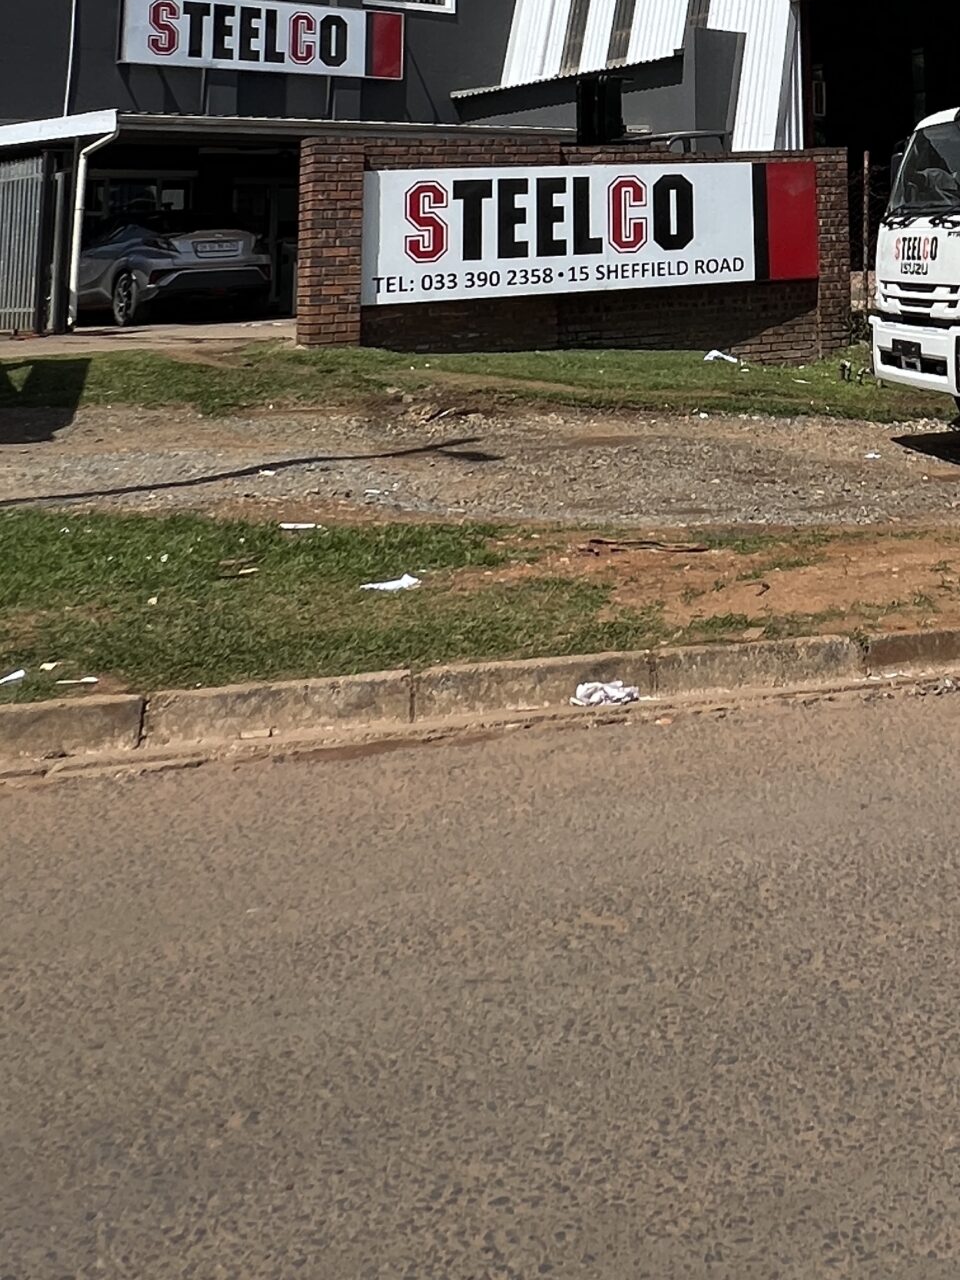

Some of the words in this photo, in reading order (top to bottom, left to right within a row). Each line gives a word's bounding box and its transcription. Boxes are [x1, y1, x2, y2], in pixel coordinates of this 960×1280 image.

[404, 174, 694, 263] STEELCO
[894, 236, 939, 262] STEELCO
[372, 275, 415, 294] TEL:
[421, 272, 459, 291] 033
[464, 269, 501, 289] 390
[595, 259, 689, 281] SHEFFIELD
[694, 256, 745, 274] ROAD
[900, 263, 929, 276] ISUZU
